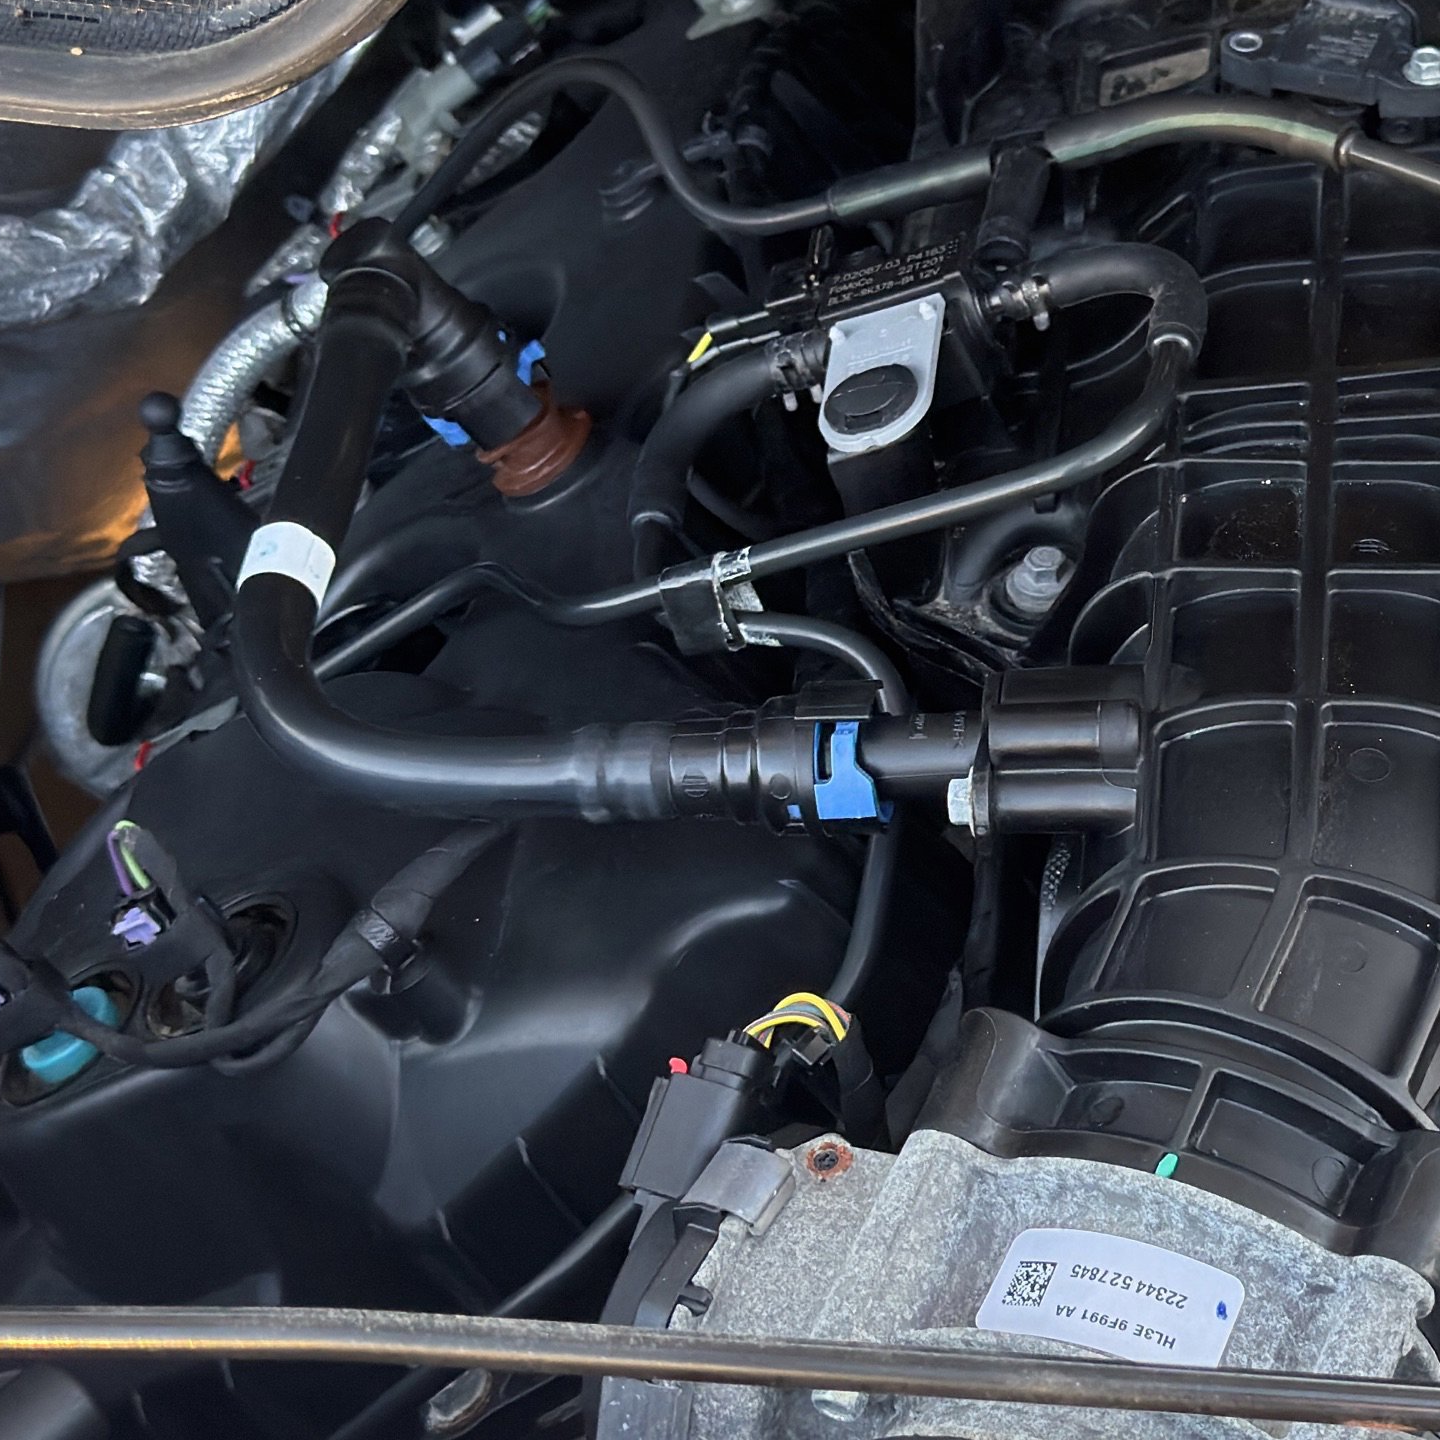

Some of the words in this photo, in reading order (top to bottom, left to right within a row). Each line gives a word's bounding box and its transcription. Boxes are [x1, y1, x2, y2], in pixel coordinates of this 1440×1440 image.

[1069, 1264, 1132, 1291] 527845
[1136, 1280, 1189, 1308] 22344
[1055, 1304, 1076, 1317] AA
[1080, 1310, 1128, 1331] 9F991
[1133, 1322, 1177, 1350] HL3E
